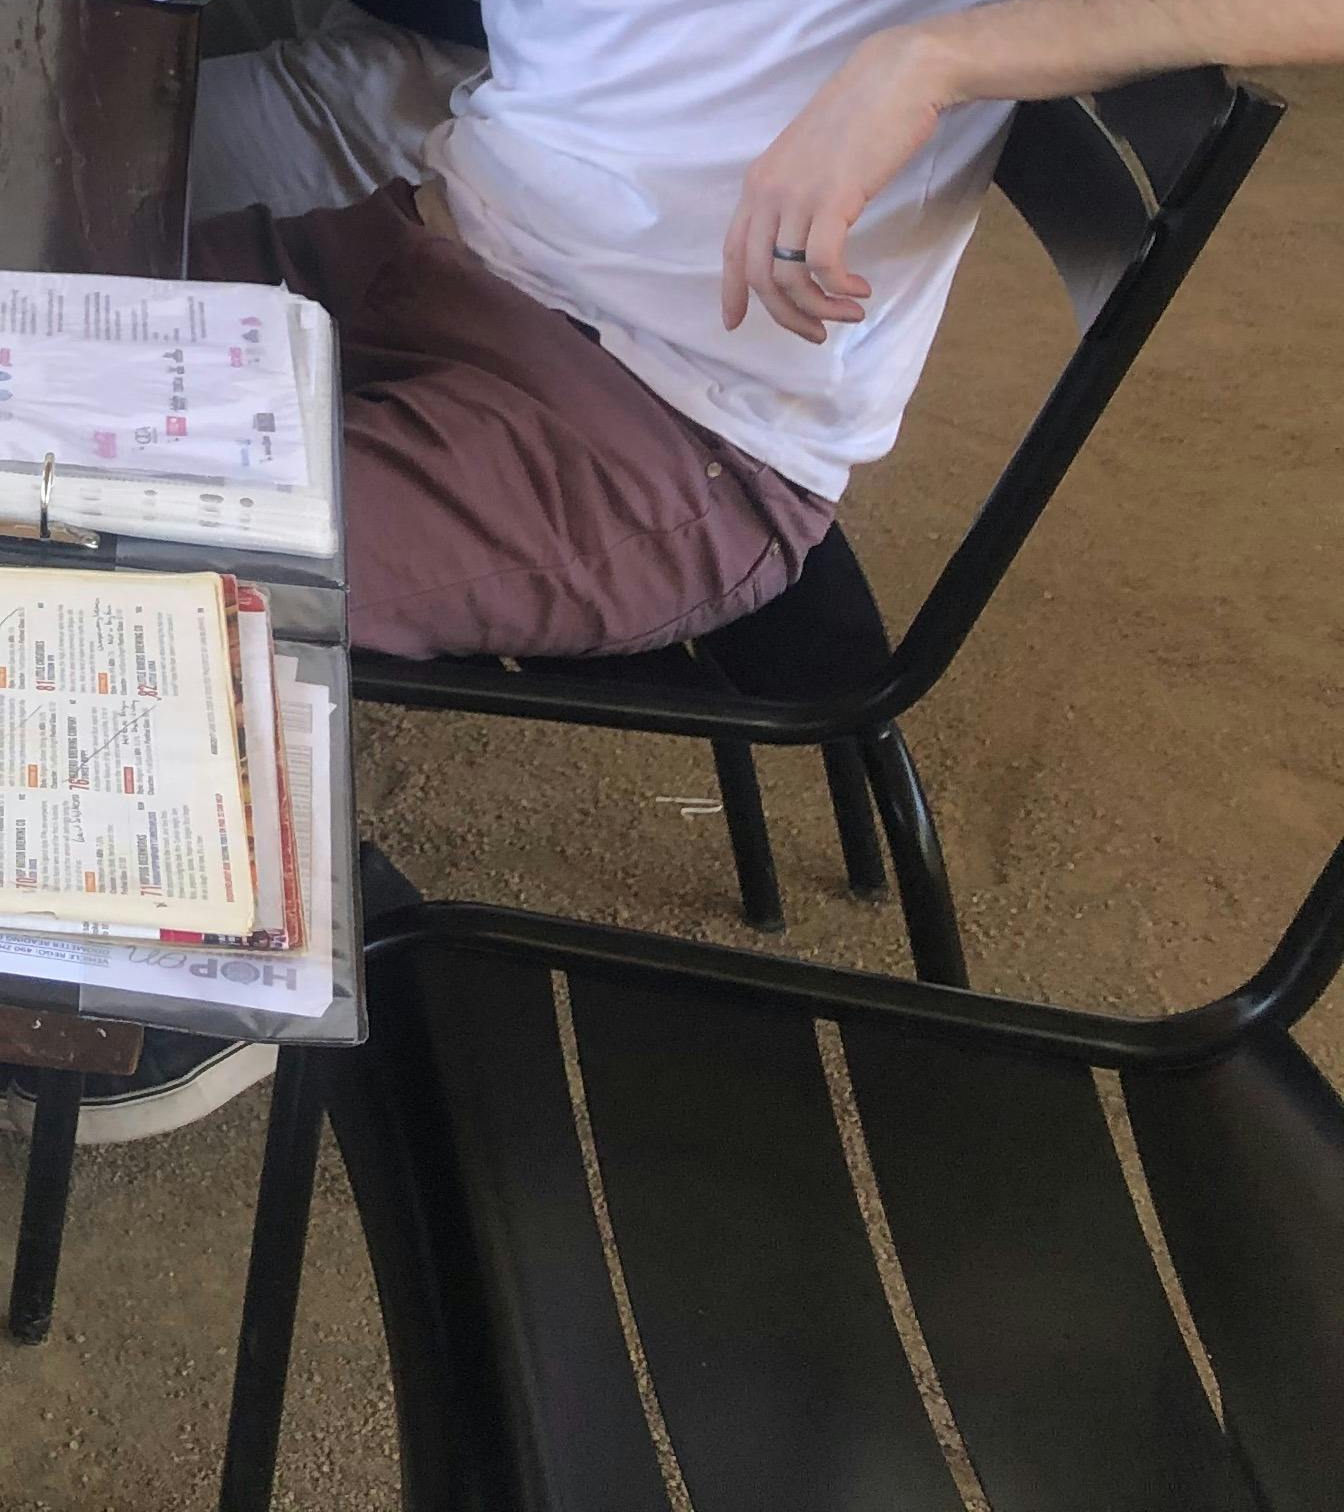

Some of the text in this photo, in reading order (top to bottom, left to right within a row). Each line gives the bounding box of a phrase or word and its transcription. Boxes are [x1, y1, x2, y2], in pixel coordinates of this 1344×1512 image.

[36, 680, 55, 690] 81
[68, 778, 89, 790] 76
[140, 884, 162, 896] 71
[190, 958, 298, 990] HOP
